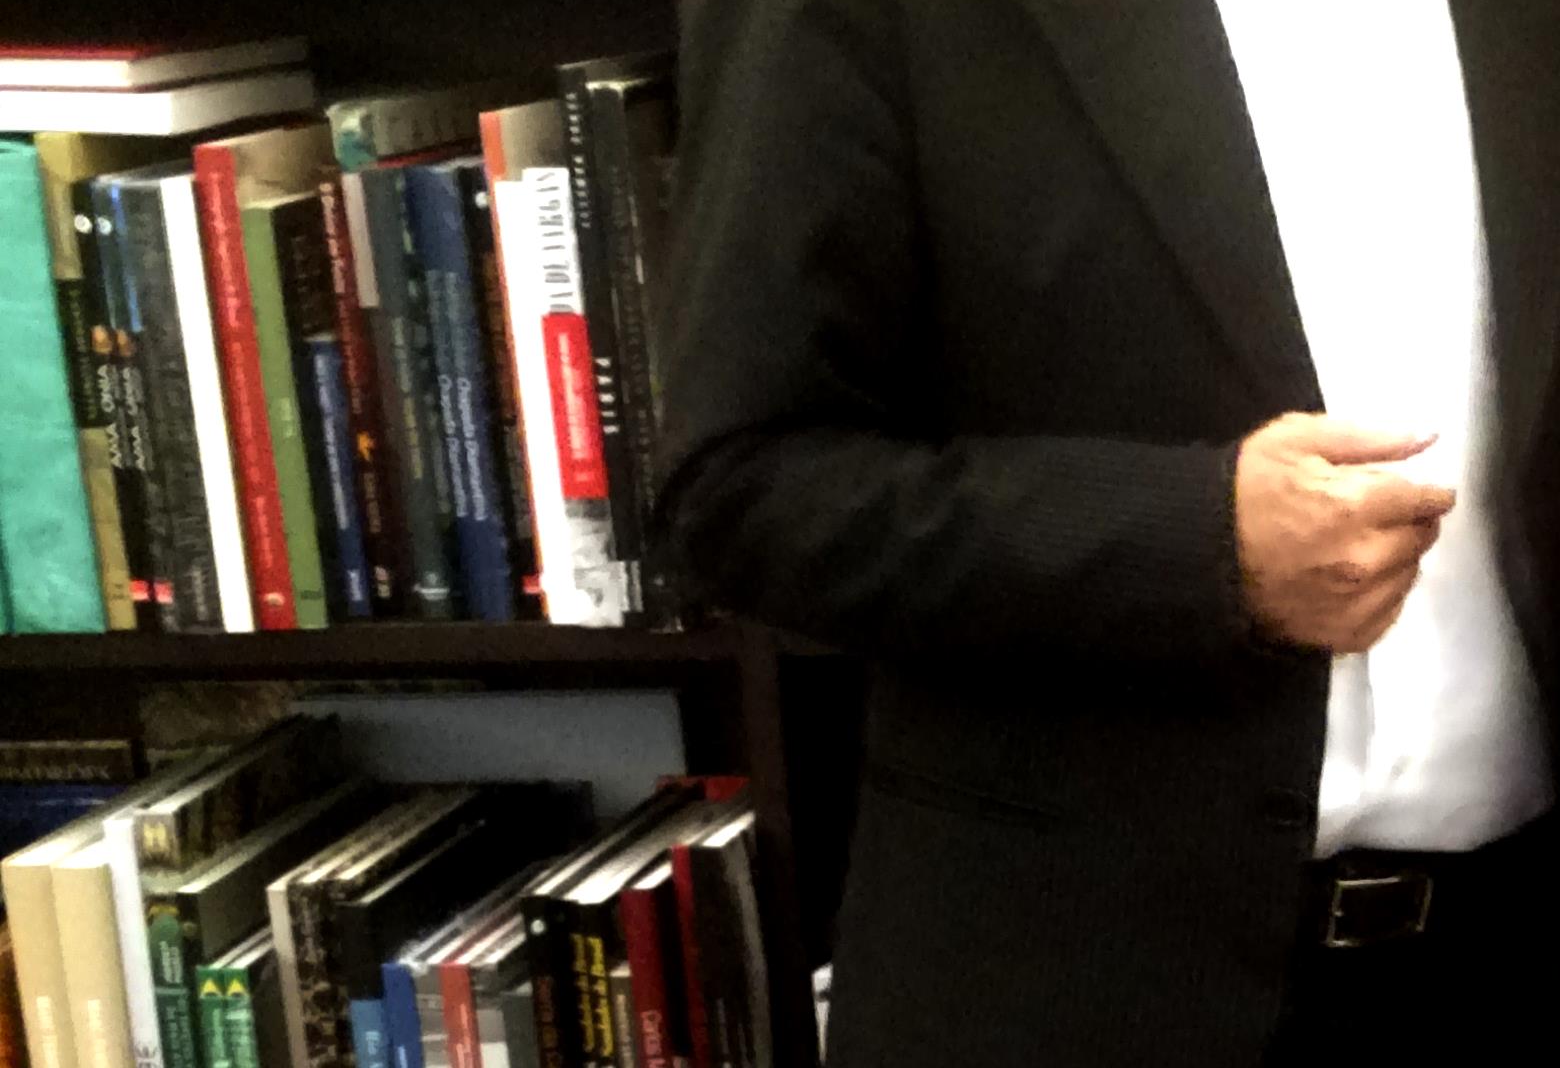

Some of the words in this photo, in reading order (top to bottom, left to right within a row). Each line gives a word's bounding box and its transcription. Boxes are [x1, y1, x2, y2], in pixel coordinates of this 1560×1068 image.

[438, 373, 458, 436] Chapada
[456, 375, 477, 439] Chapada
[592, 355, 616, 435] PARIS
